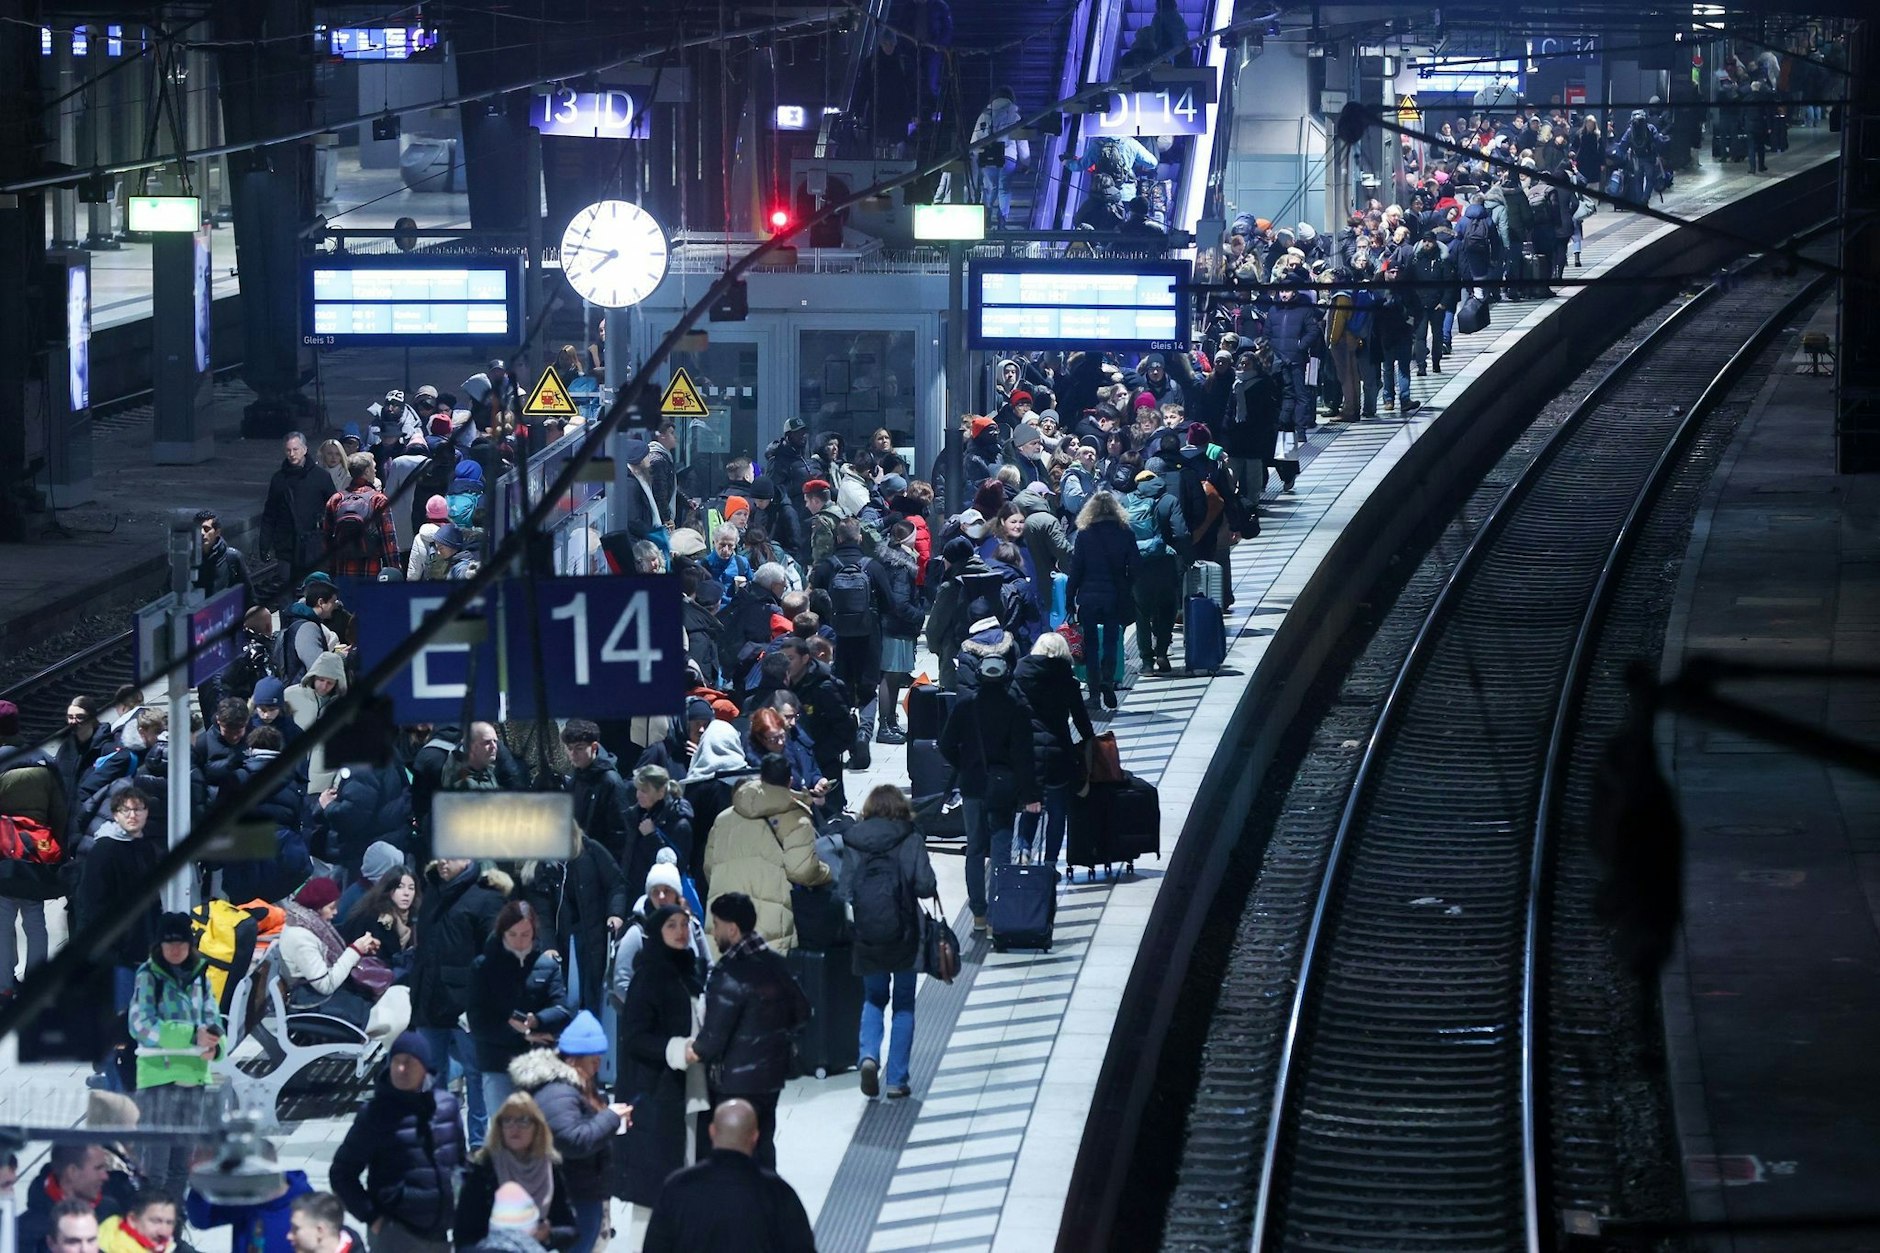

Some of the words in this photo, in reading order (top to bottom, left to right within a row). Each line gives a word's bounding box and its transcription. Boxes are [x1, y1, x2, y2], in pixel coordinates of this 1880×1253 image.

[1572, 37, 1595, 60] 14
[538, 87, 578, 124] 13
[604, 89, 634, 129] D
[1099, 91, 1129, 128] D
[1155, 87, 1198, 123] 14
[303, 335, 324, 344] Gleis
[326, 335, 335, 344] 13
[1150, 341, 1172, 350] Gleis
[1174, 342, 1184, 350] 14
[409, 596, 486, 699] E
[551, 590, 663, 685] 14
